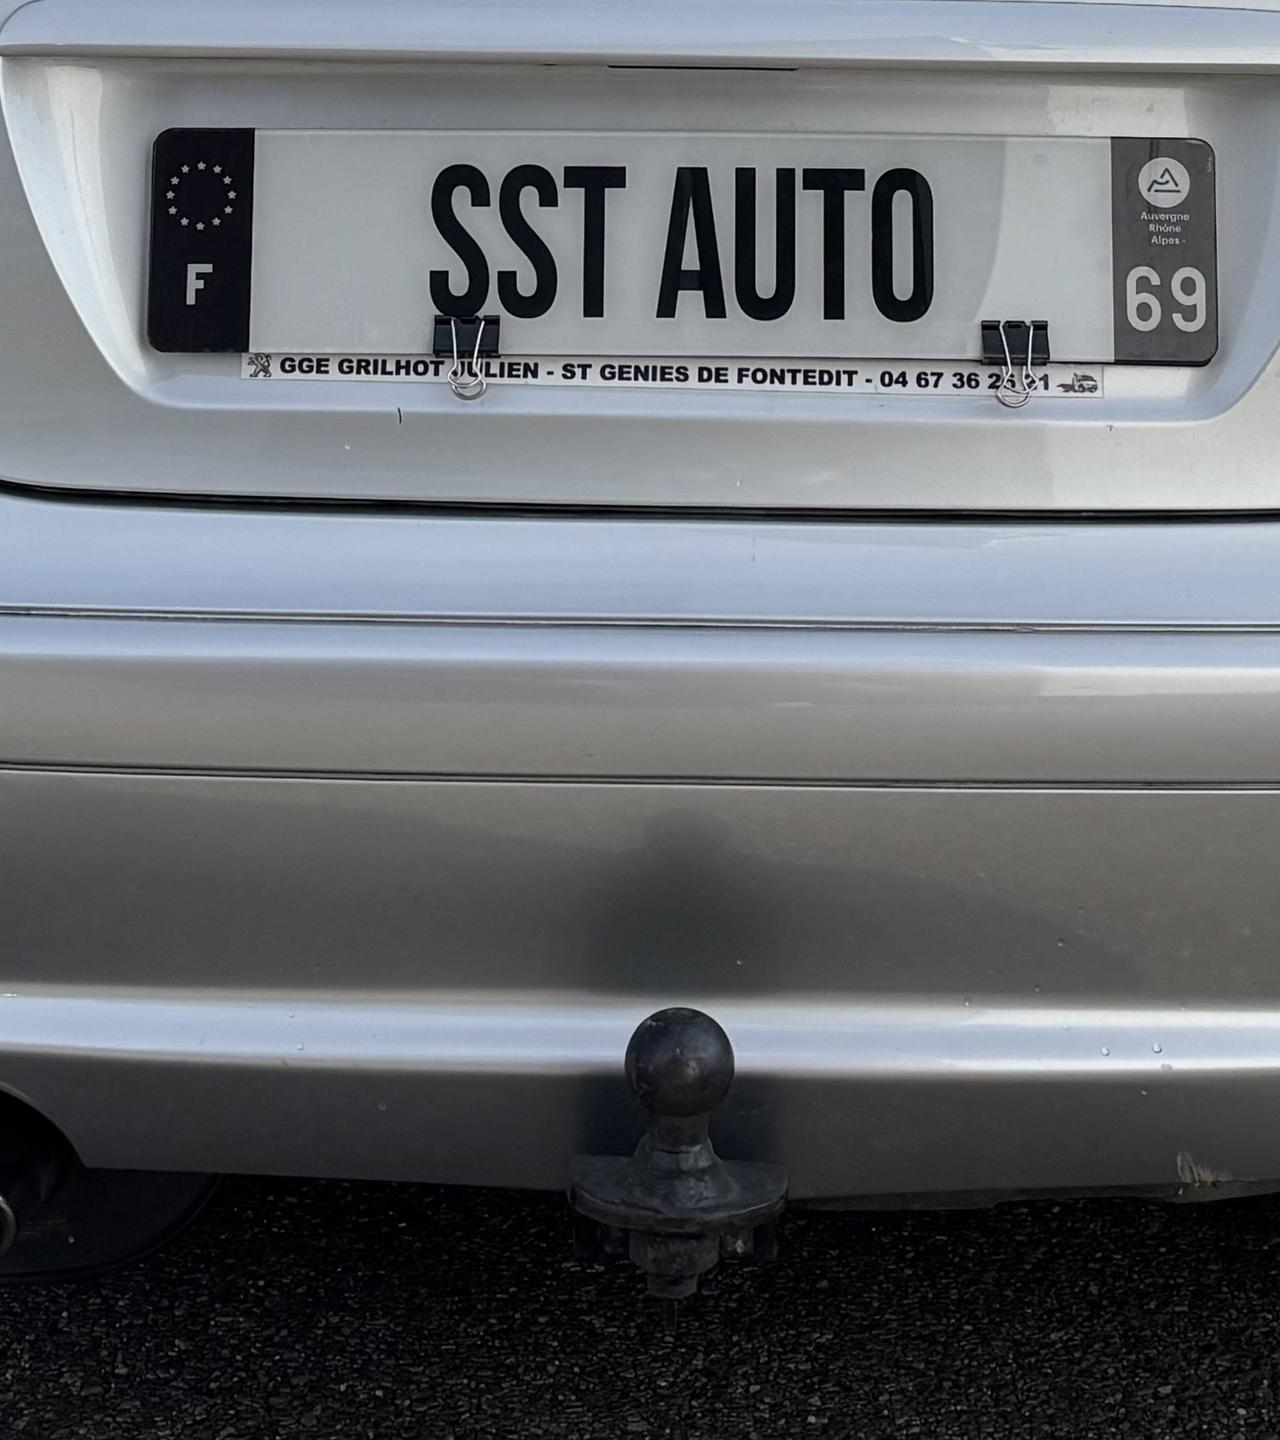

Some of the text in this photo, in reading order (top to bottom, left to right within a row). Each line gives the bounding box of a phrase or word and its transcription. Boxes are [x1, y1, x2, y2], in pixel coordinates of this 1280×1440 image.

[1140, 211, 1191, 223] Auvergne
[428, 163, 935, 323] SST AUTO
[1150, 234, 1180, 246] Alpes
[184, 263, 214, 307] F
[1125, 265, 1207, 333] 69
[279, 356, 330, 375] GGE
[336, 357, 445, 378] GRILHOT
[561, 363, 593, 381] ST
[599, 364, 689, 384] GENIES
[696, 366, 730, 384] DE
[736, 366, 859, 388] FONTEDIT
[879, 370, 909, 389] 04
[915, 371, 945, 390] 67
[951, 372, 981, 390] 36
